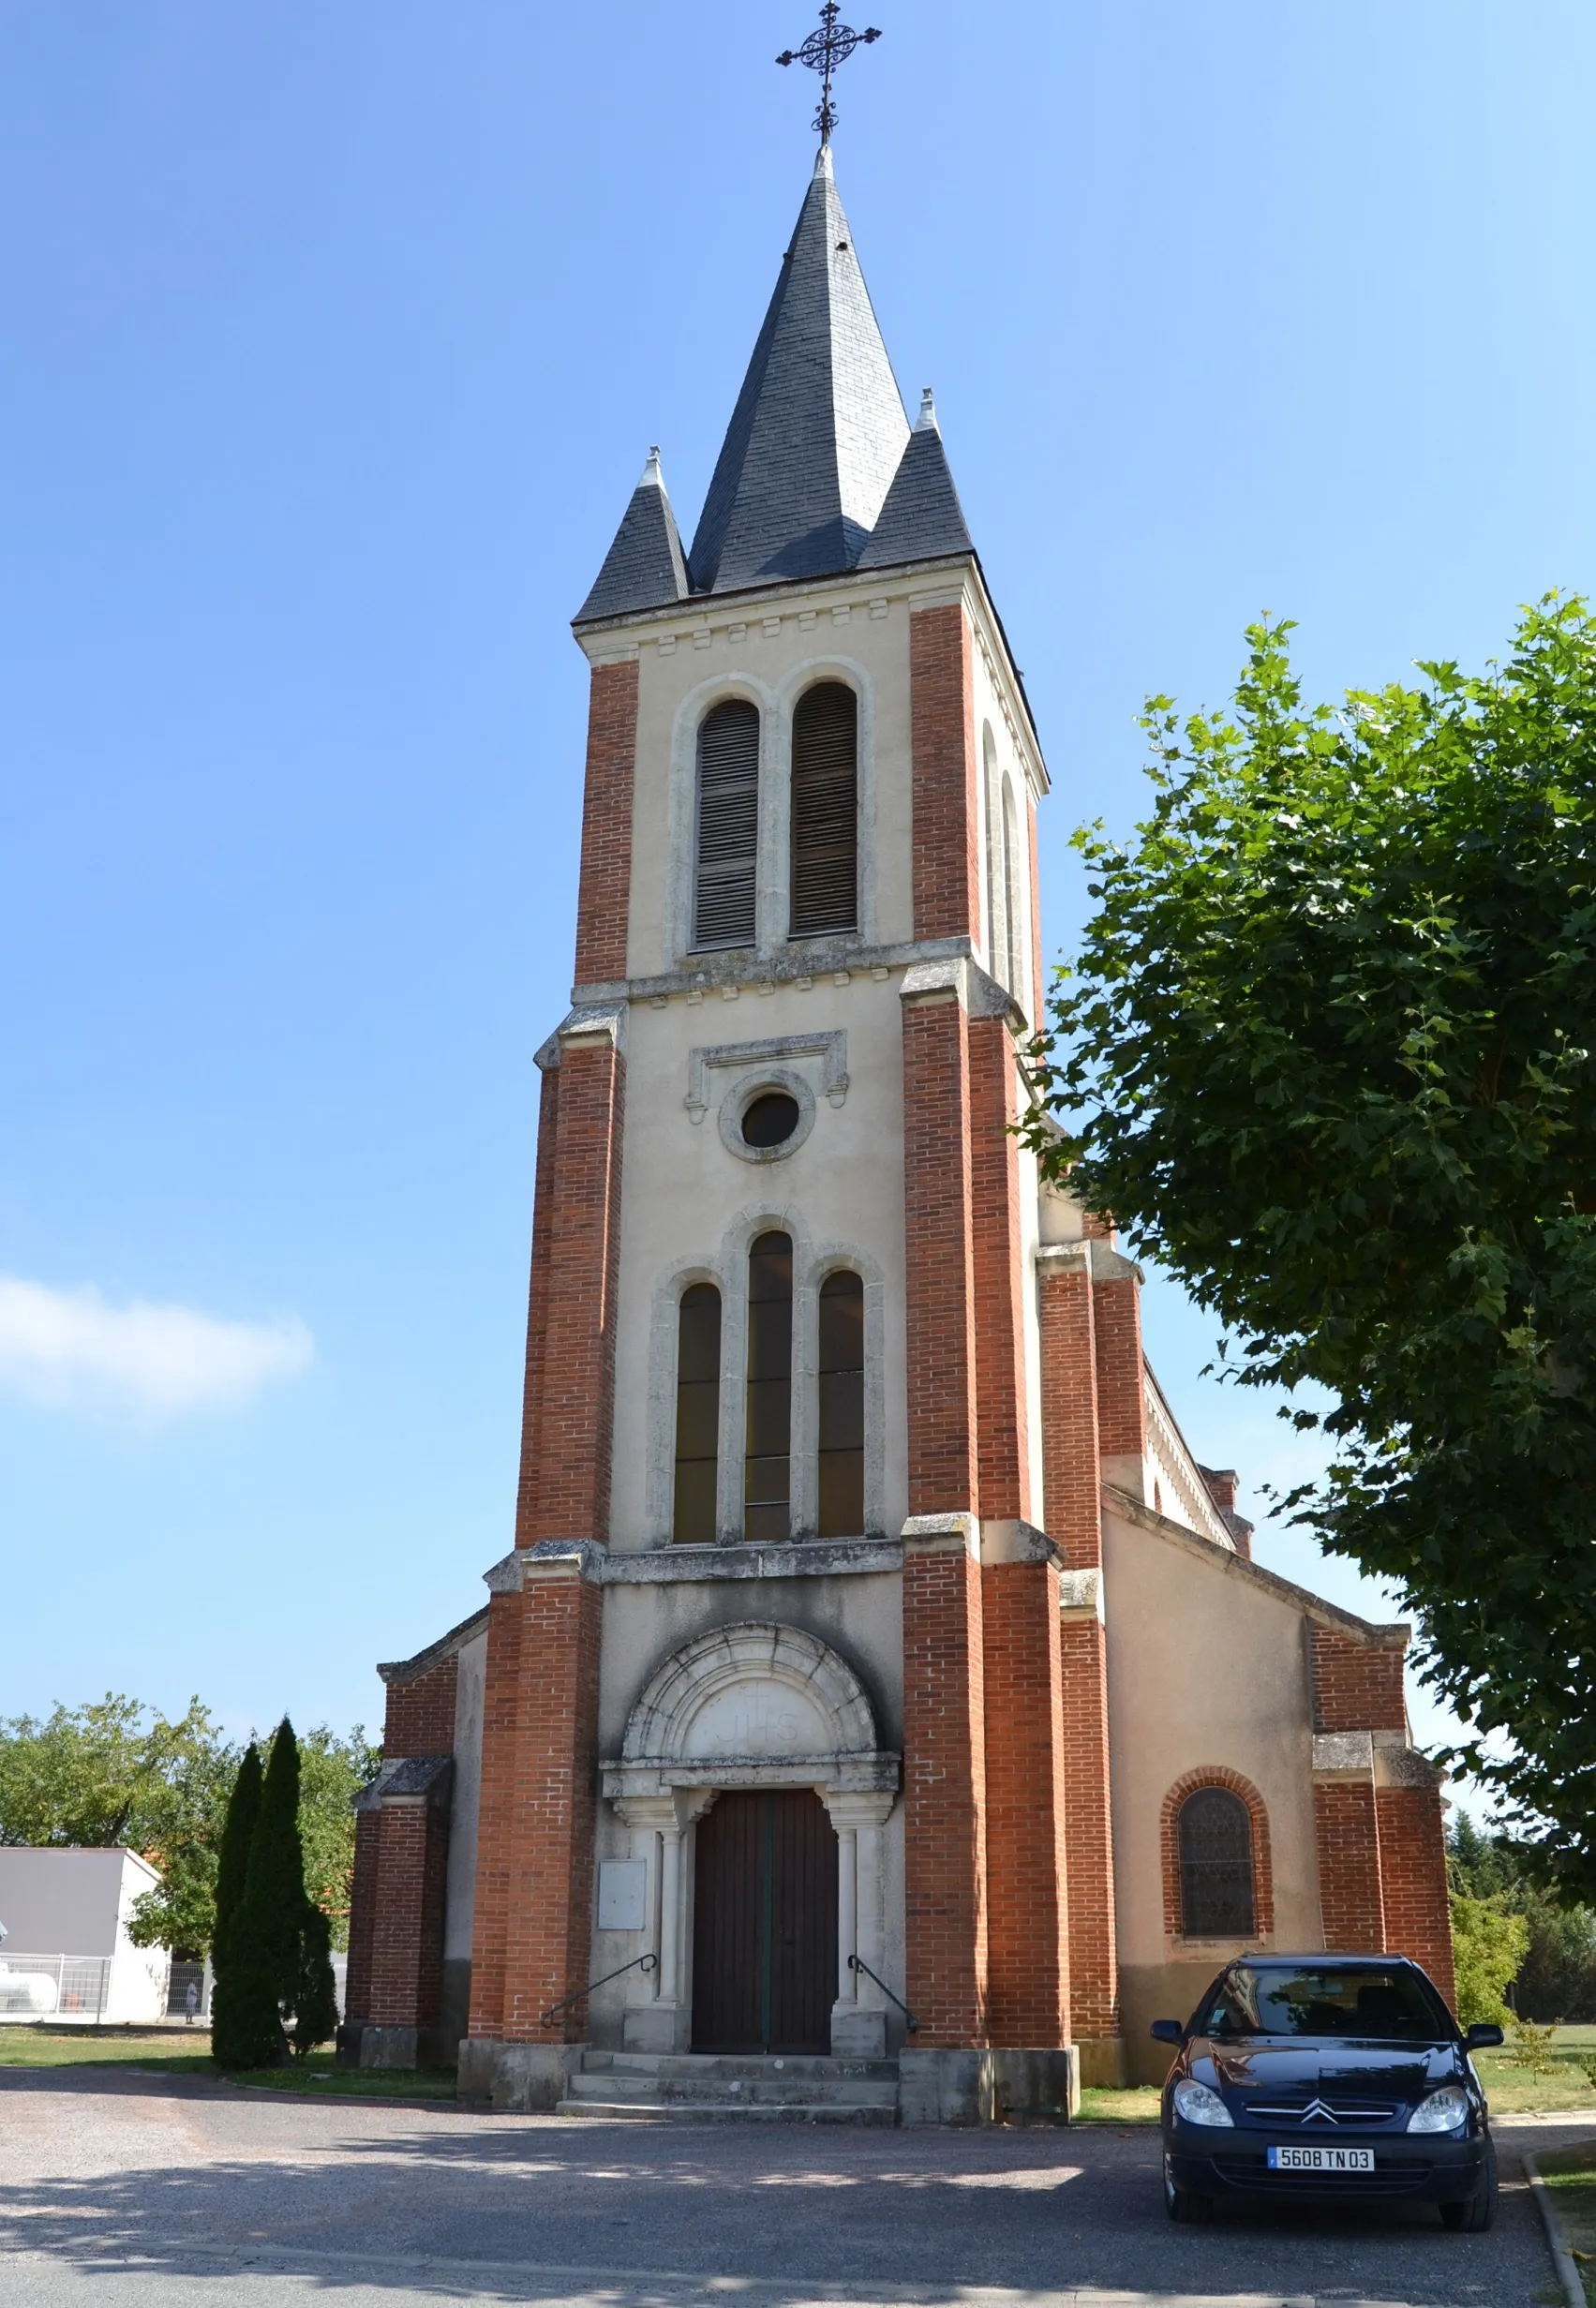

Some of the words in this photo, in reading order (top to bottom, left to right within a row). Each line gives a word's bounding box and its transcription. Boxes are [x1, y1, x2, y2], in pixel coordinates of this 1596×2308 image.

[1281, 2150, 1321, 2167] 5608
[1326, 2151, 1345, 2167] TN
[1350, 2152, 1369, 2168] 03
